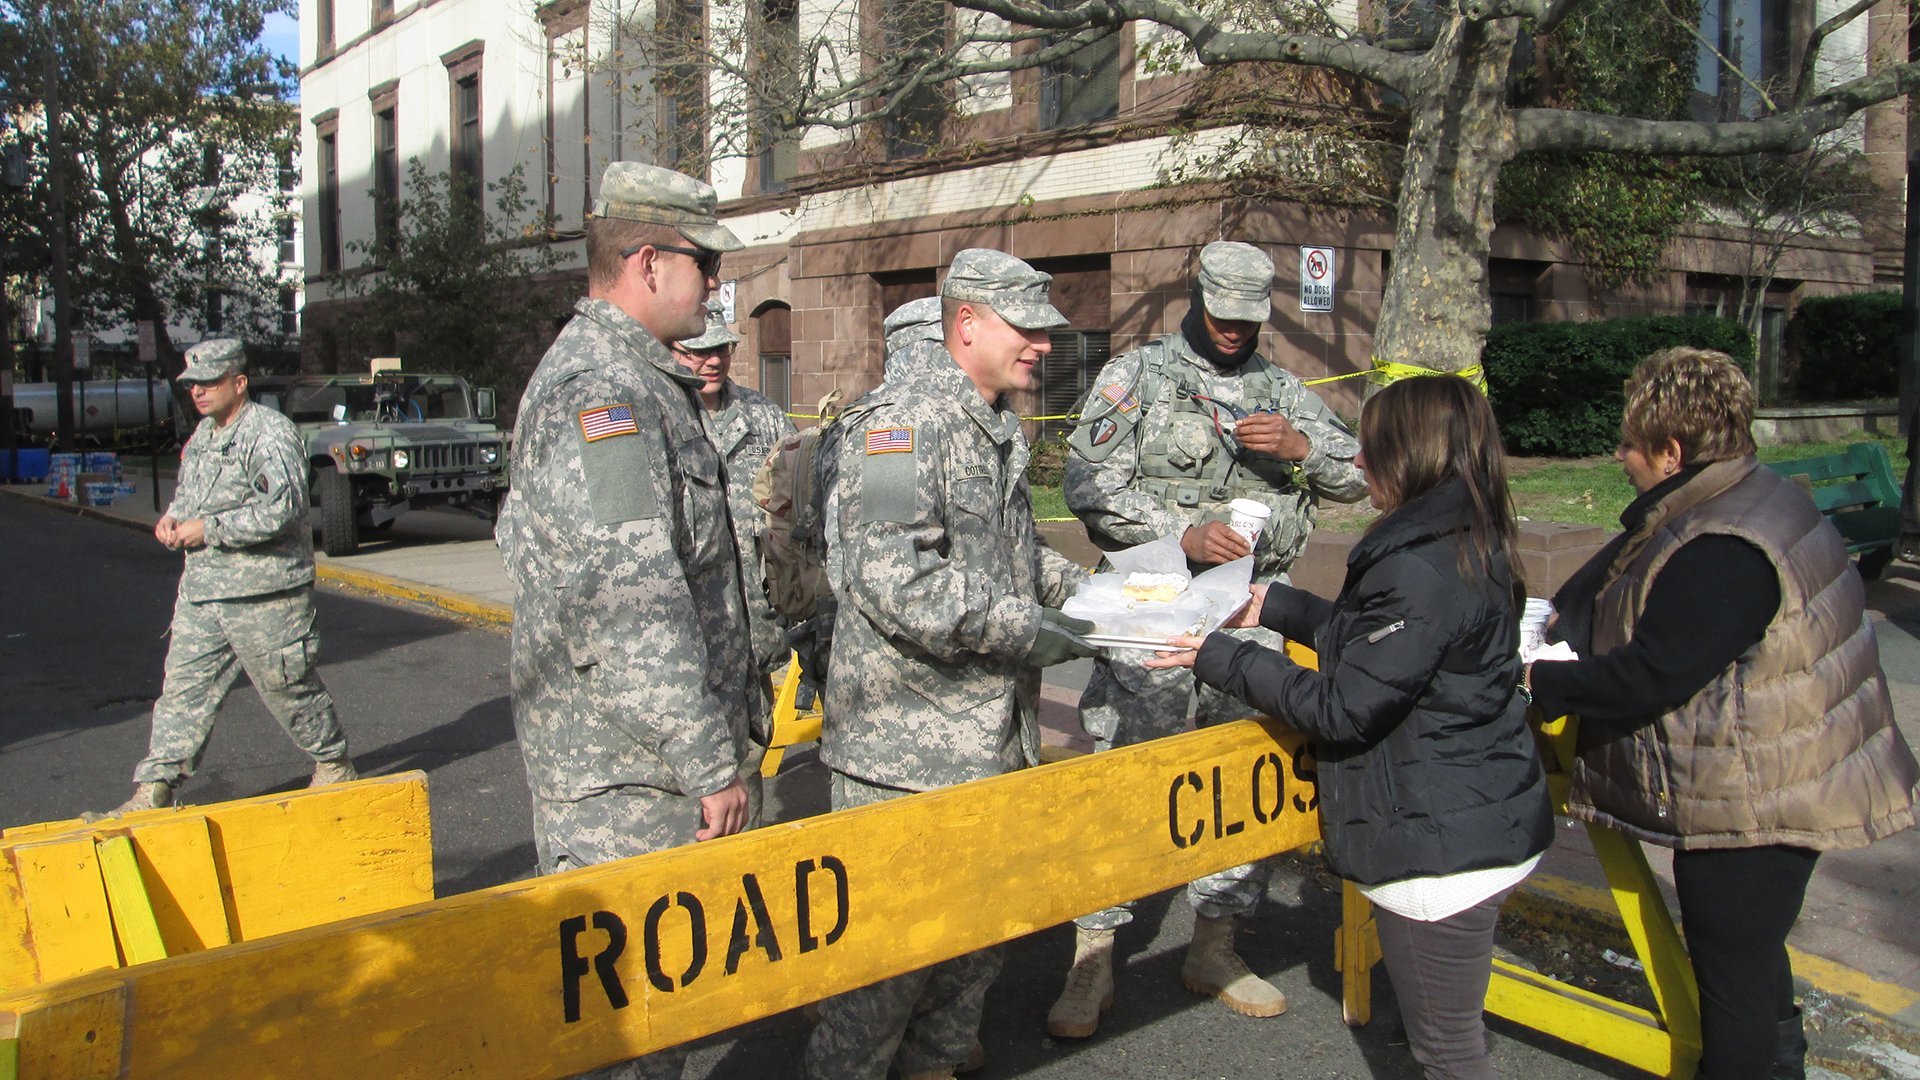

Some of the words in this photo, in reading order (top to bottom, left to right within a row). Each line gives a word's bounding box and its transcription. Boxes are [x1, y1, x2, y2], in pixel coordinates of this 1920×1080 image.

[1304, 285, 1313, 294] NO
[1314, 285, 1330, 295] DOGS
[1303, 296, 1331, 306] ALLOWED
[560, 855, 850, 1023] ROAD
